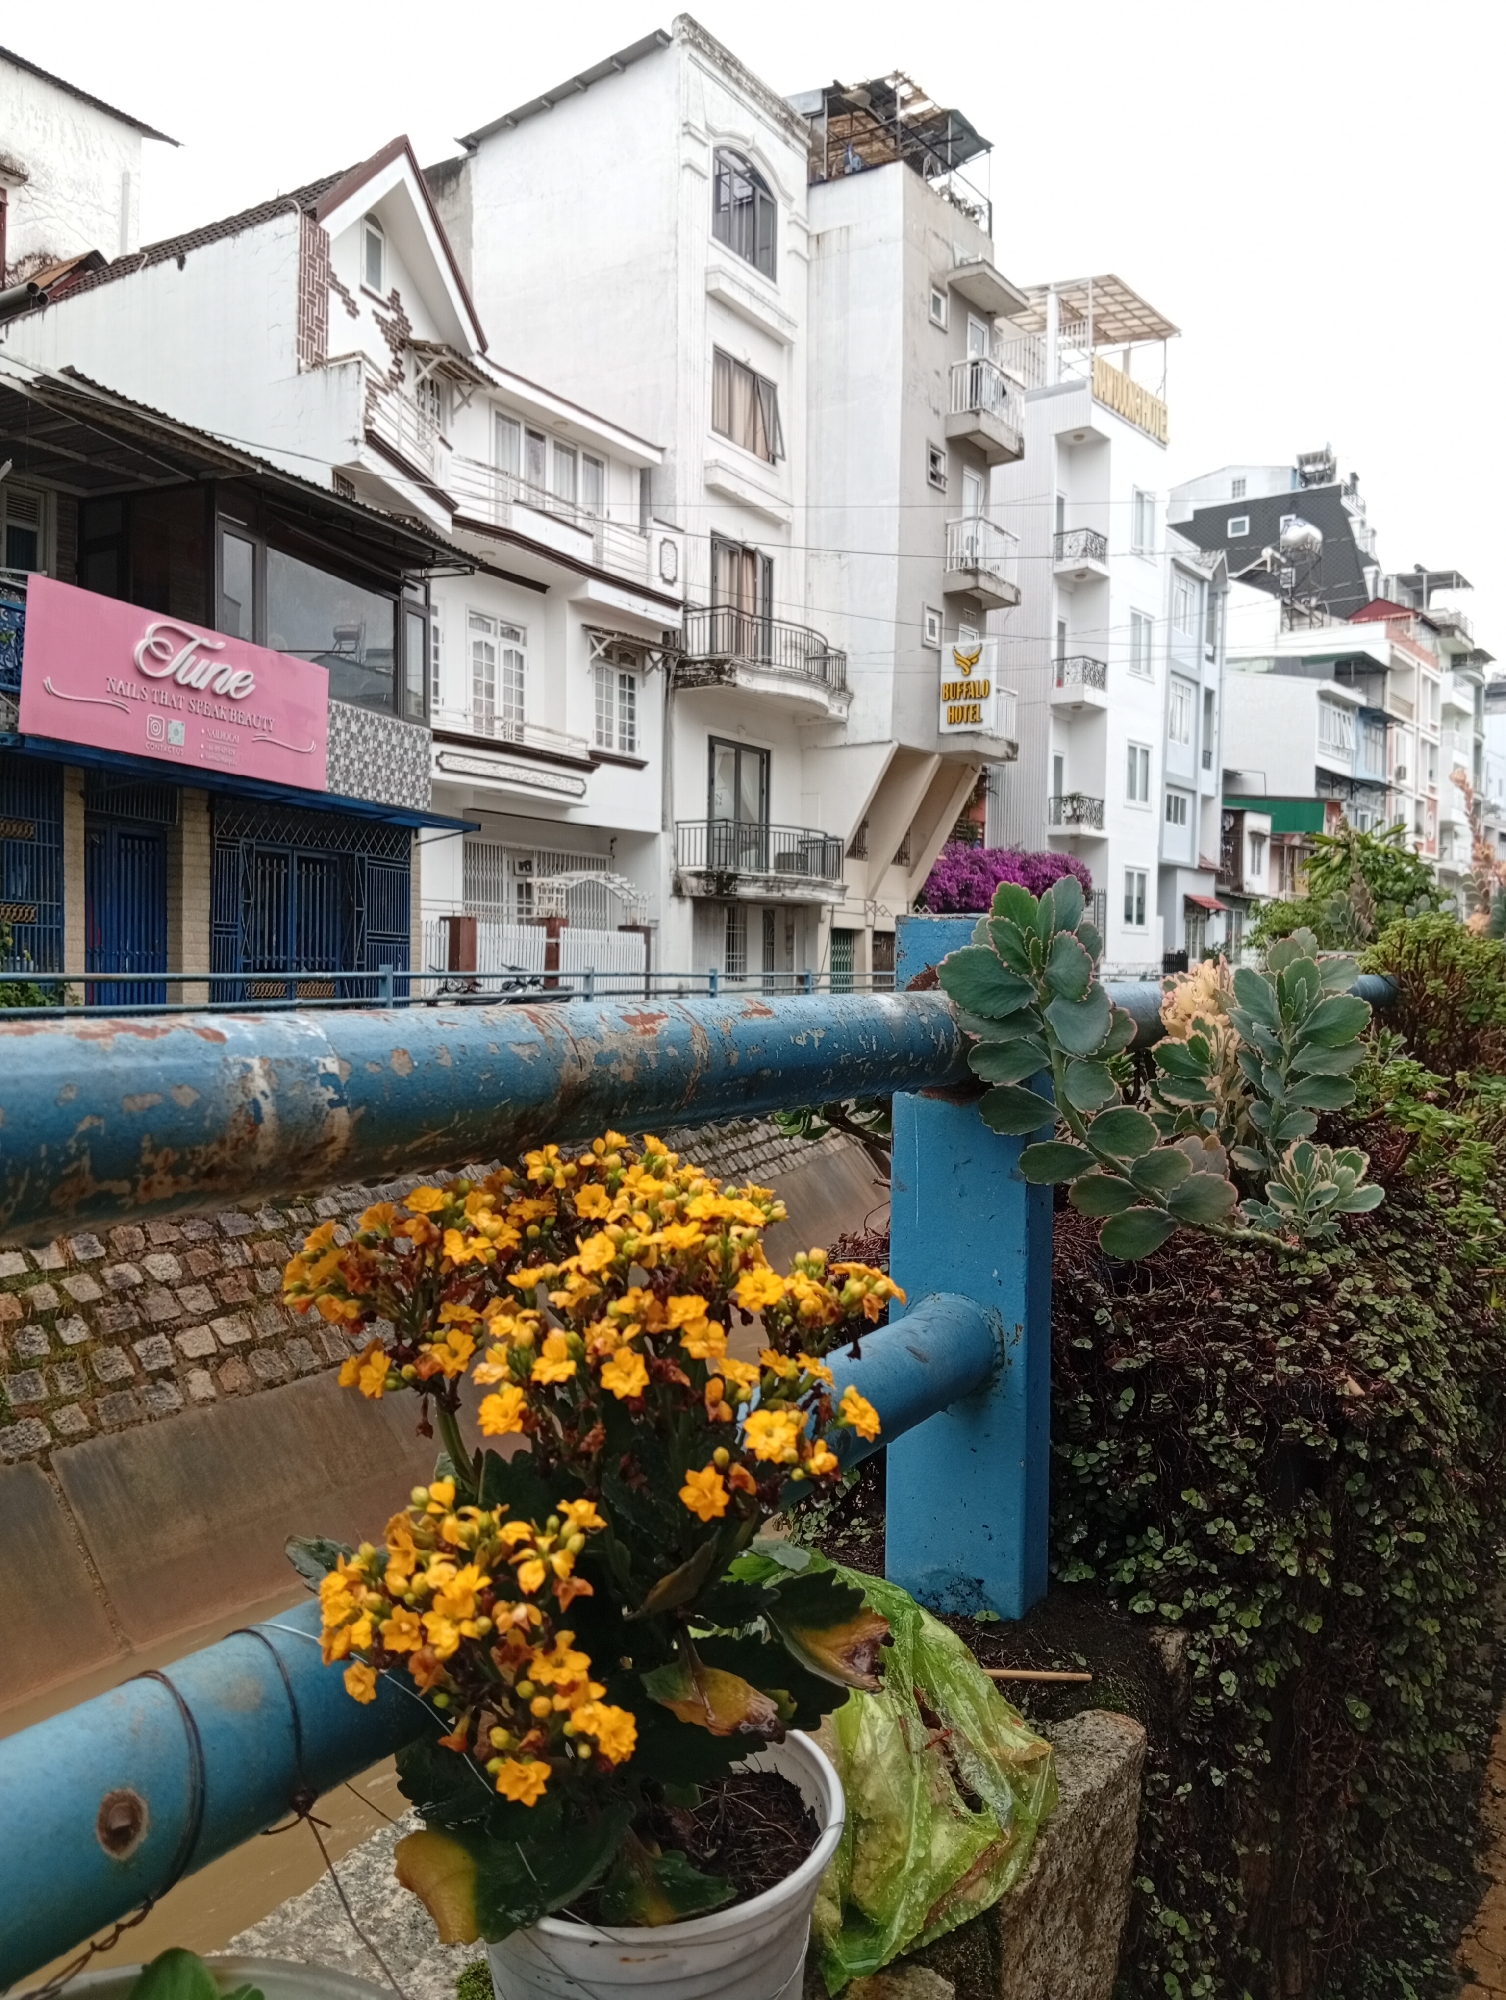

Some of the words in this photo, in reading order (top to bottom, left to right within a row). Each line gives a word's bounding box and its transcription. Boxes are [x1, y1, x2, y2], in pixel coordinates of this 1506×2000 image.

[942, 679, 990, 701] BUFFALO
[106, 676, 148, 701] NAILS
[152, 688, 184, 711] THAT
[188, 698, 227, 722] SPEAK
[229, 708, 275, 733] BEAUTY
[947, 704, 982, 725] HOTEL
